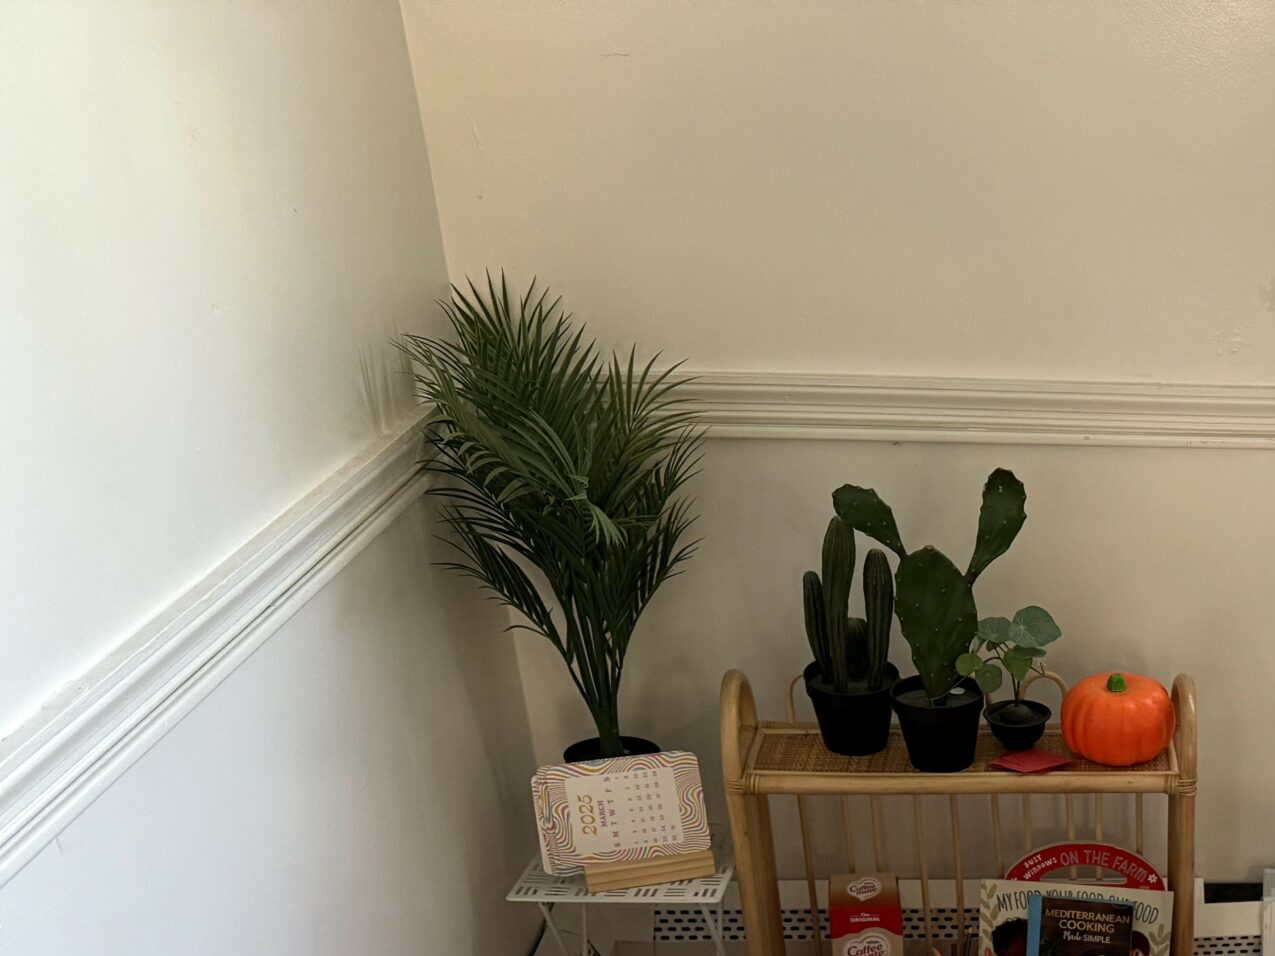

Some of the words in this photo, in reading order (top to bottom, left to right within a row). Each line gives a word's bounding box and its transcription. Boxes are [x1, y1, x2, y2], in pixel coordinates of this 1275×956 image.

[577, 794, 598, 836] 2025
[597, 800, 608, 827] MARCH
[1060, 850, 1080, 866] ON
[1083, 849, 1110, 866] THE
[850, 884, 876, 892] Coffee
[996, 893, 1013, 911] MY
[1045, 908, 1131, 924] MEDITERRANEAN
[1059, 919, 1115, 933] COOKING
[1063, 930, 1083, 941] Made
[1083, 933, 1112, 944] SIMPLE
